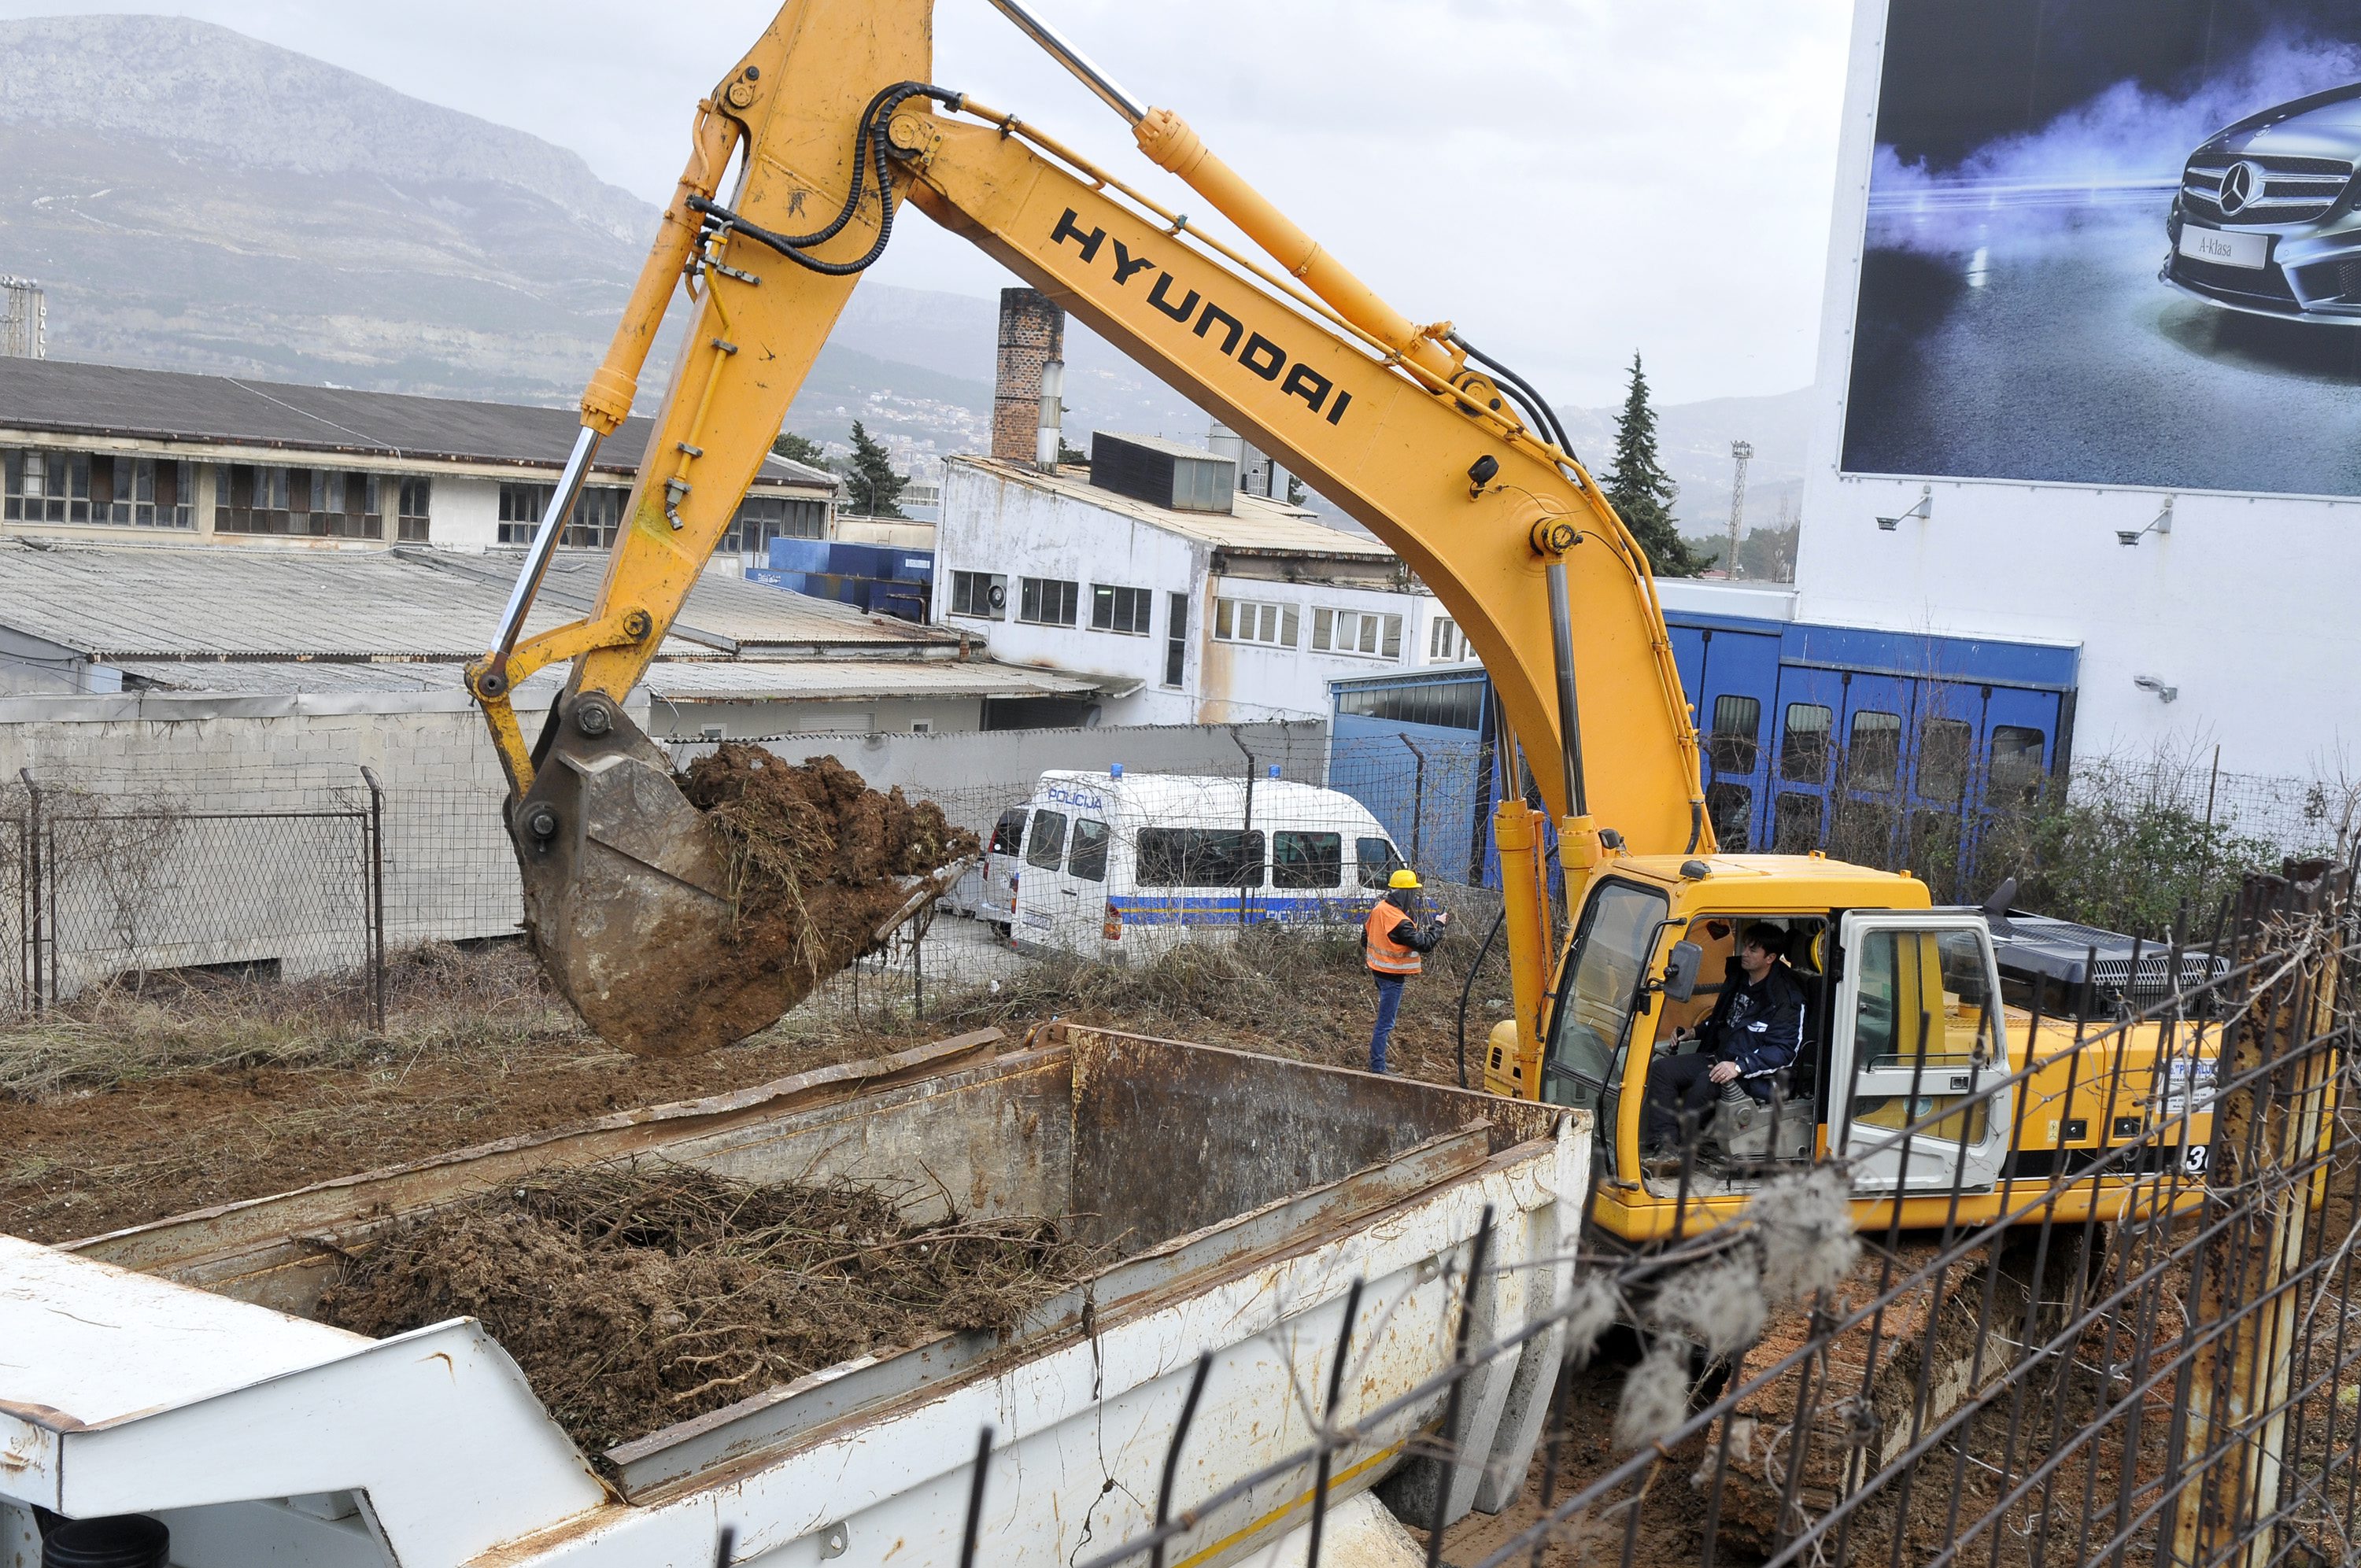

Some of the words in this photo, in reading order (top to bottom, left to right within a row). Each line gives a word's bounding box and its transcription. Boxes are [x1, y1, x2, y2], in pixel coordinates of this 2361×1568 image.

[2199, 237, 2232, 257] A-klasa
[1050, 207, 1353, 426] HYUNDAI
[1047, 788, 1103, 810] POLICIJA
